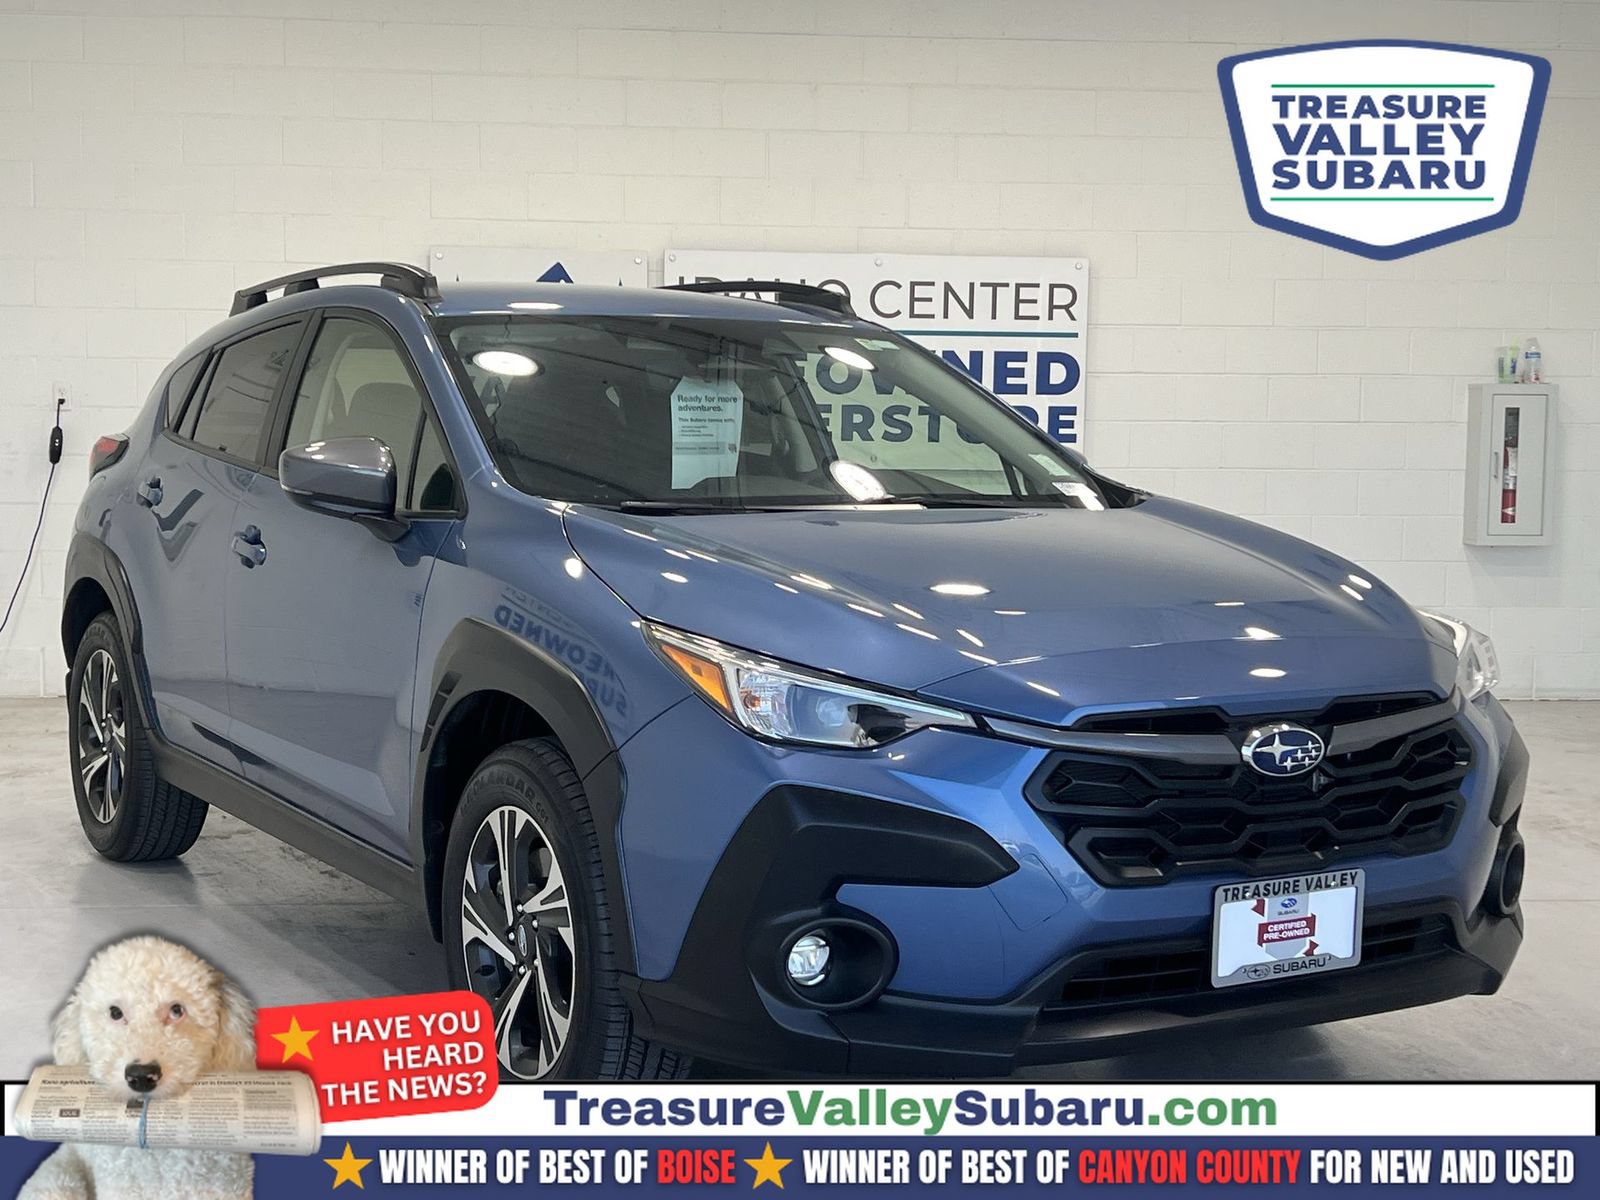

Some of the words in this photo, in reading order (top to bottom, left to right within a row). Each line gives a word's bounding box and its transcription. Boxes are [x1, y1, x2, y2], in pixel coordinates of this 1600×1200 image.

[870, 281, 1077, 322] CENTER
[678, 394, 702, 404] Ready
[705, 394, 716, 403] for
[678, 404, 723, 412] adventures.
[1223, 879, 1300, 902] TREASURE
[1305, 871, 1358, 891] VALLEY
[1267, 920, 1307, 932] CERTIFIED
[1263, 928, 1310, 941] PRE-OWNED
[1273, 957, 1326, 974] SUBARU
